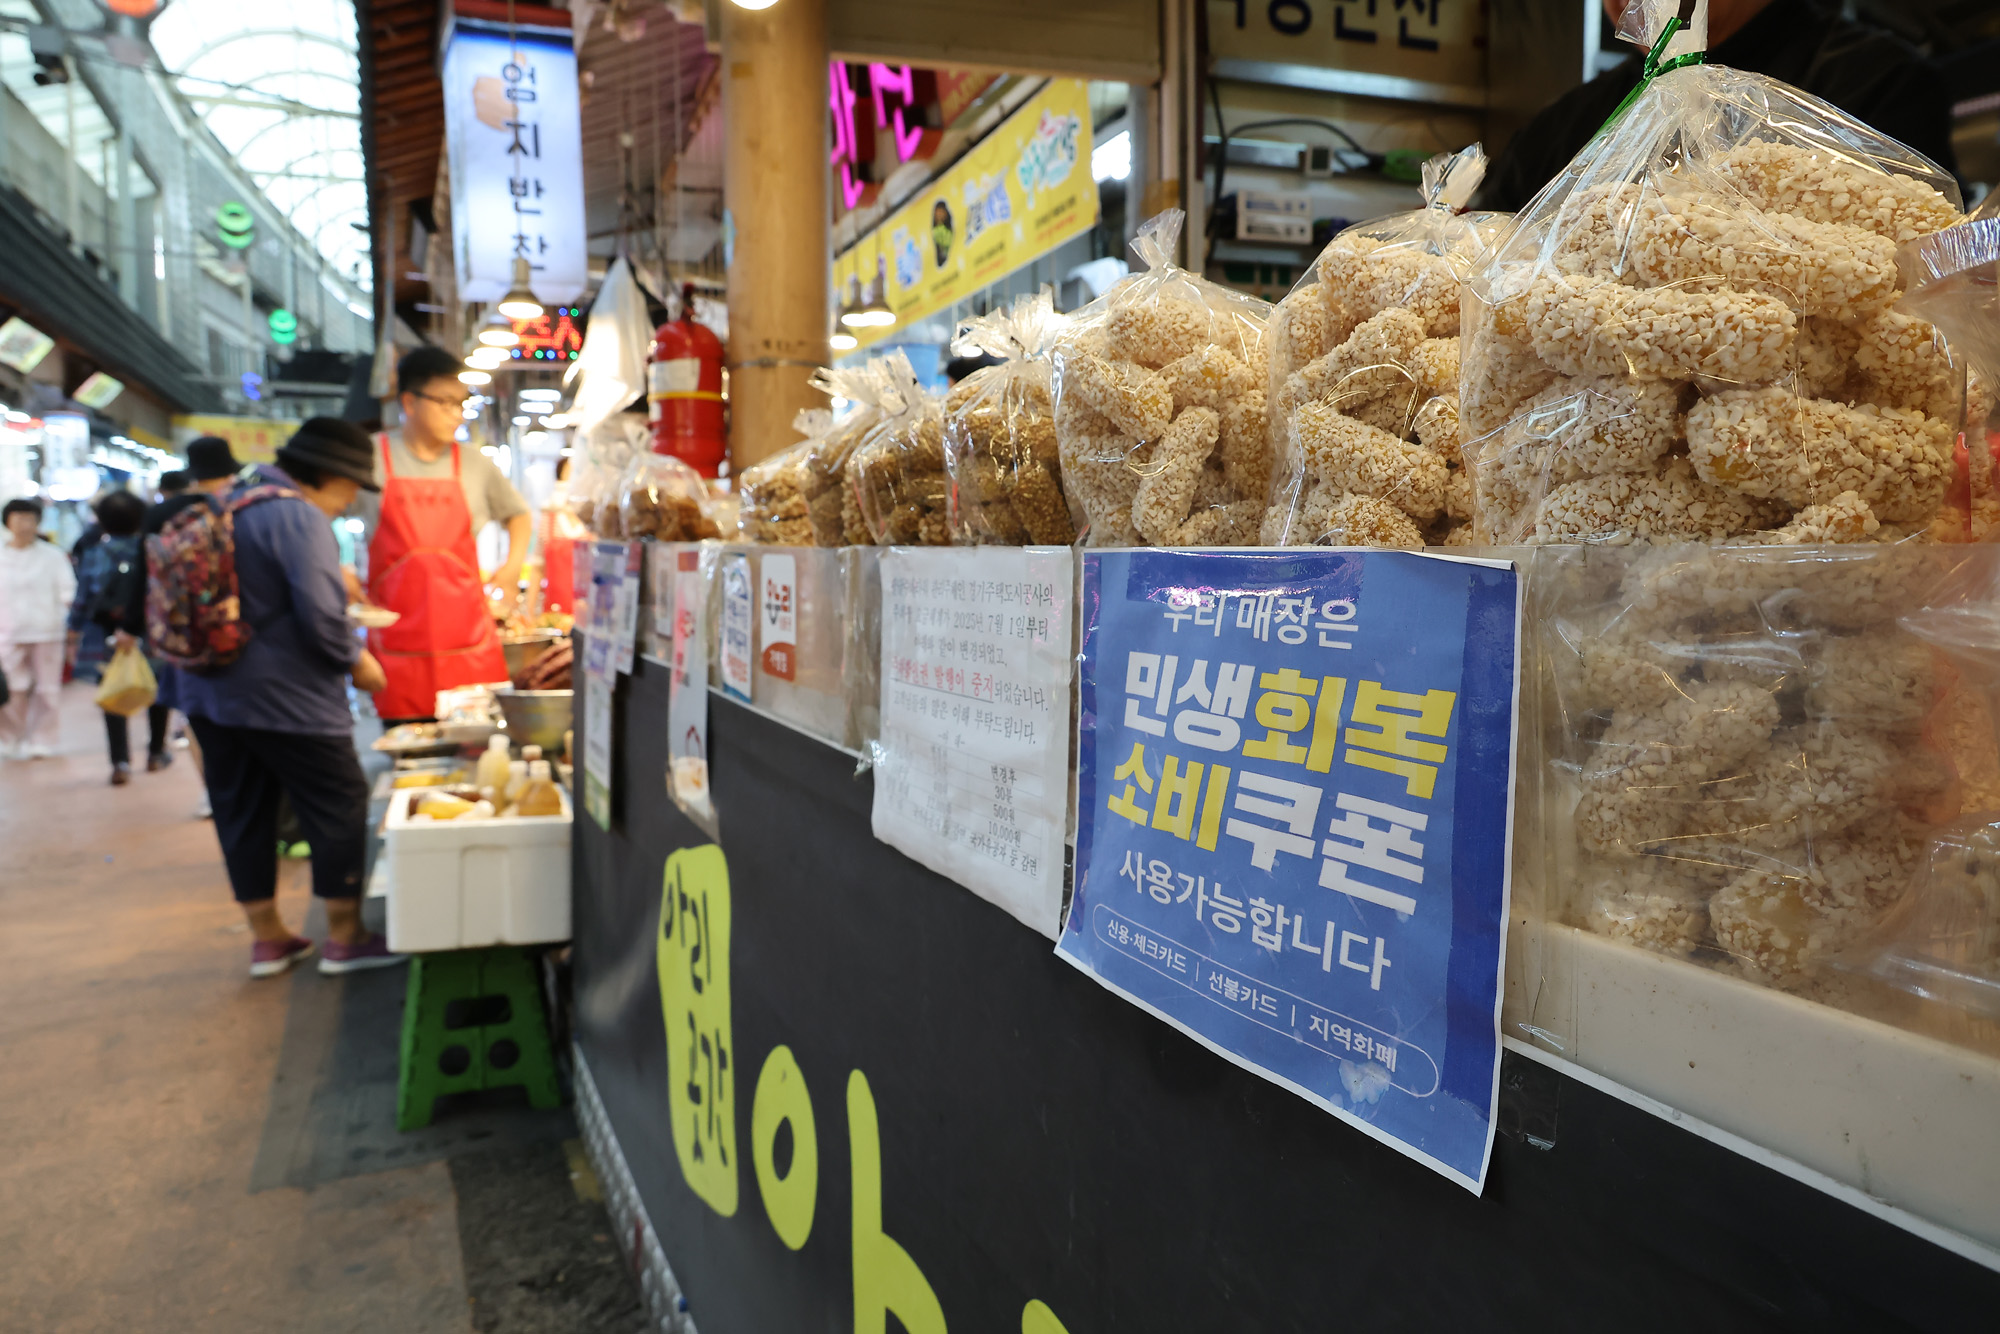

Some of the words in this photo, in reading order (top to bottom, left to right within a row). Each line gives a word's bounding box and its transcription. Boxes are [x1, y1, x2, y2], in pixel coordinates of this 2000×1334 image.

[968, 580, 1054, 607] 경기주택도시공사의
[953, 610, 984, 634] 2025년
[988, 614, 1004, 636] 7월
[1163, 592, 1223, 637] 우리
[1236, 594, 1359, 650] 매장은
[938, 636, 955, 658] 같이
[959, 639, 1008, 668] 변경되었고,
[934, 665, 965, 694] 발행이
[971, 671, 1049, 712] 중지되었습니다.
[974, 709, 1037, 745] 부탁드립니다.
[1123, 650, 1457, 800] 민생회복
[990, 764, 1017, 785] 변경후
[994, 784, 1013, 805] 30분
[992, 803, 1015, 826] 500원
[1107, 742, 1429, 916] 소비쿠폰
[987, 820, 1022, 849] 10,000원
[969, 832, 1007, 862] 국가유공자
[1008, 850, 1019, 866] 등
[1021, 853, 1038, 877] 감면
[1118, 850, 1392, 991] 사용가능합니다
[1107, 918, 1188, 975] 신용·체크카드
[1208, 970, 1279, 1019] 선불카드
[1309, 1014, 1398, 1073] 지역화폐
